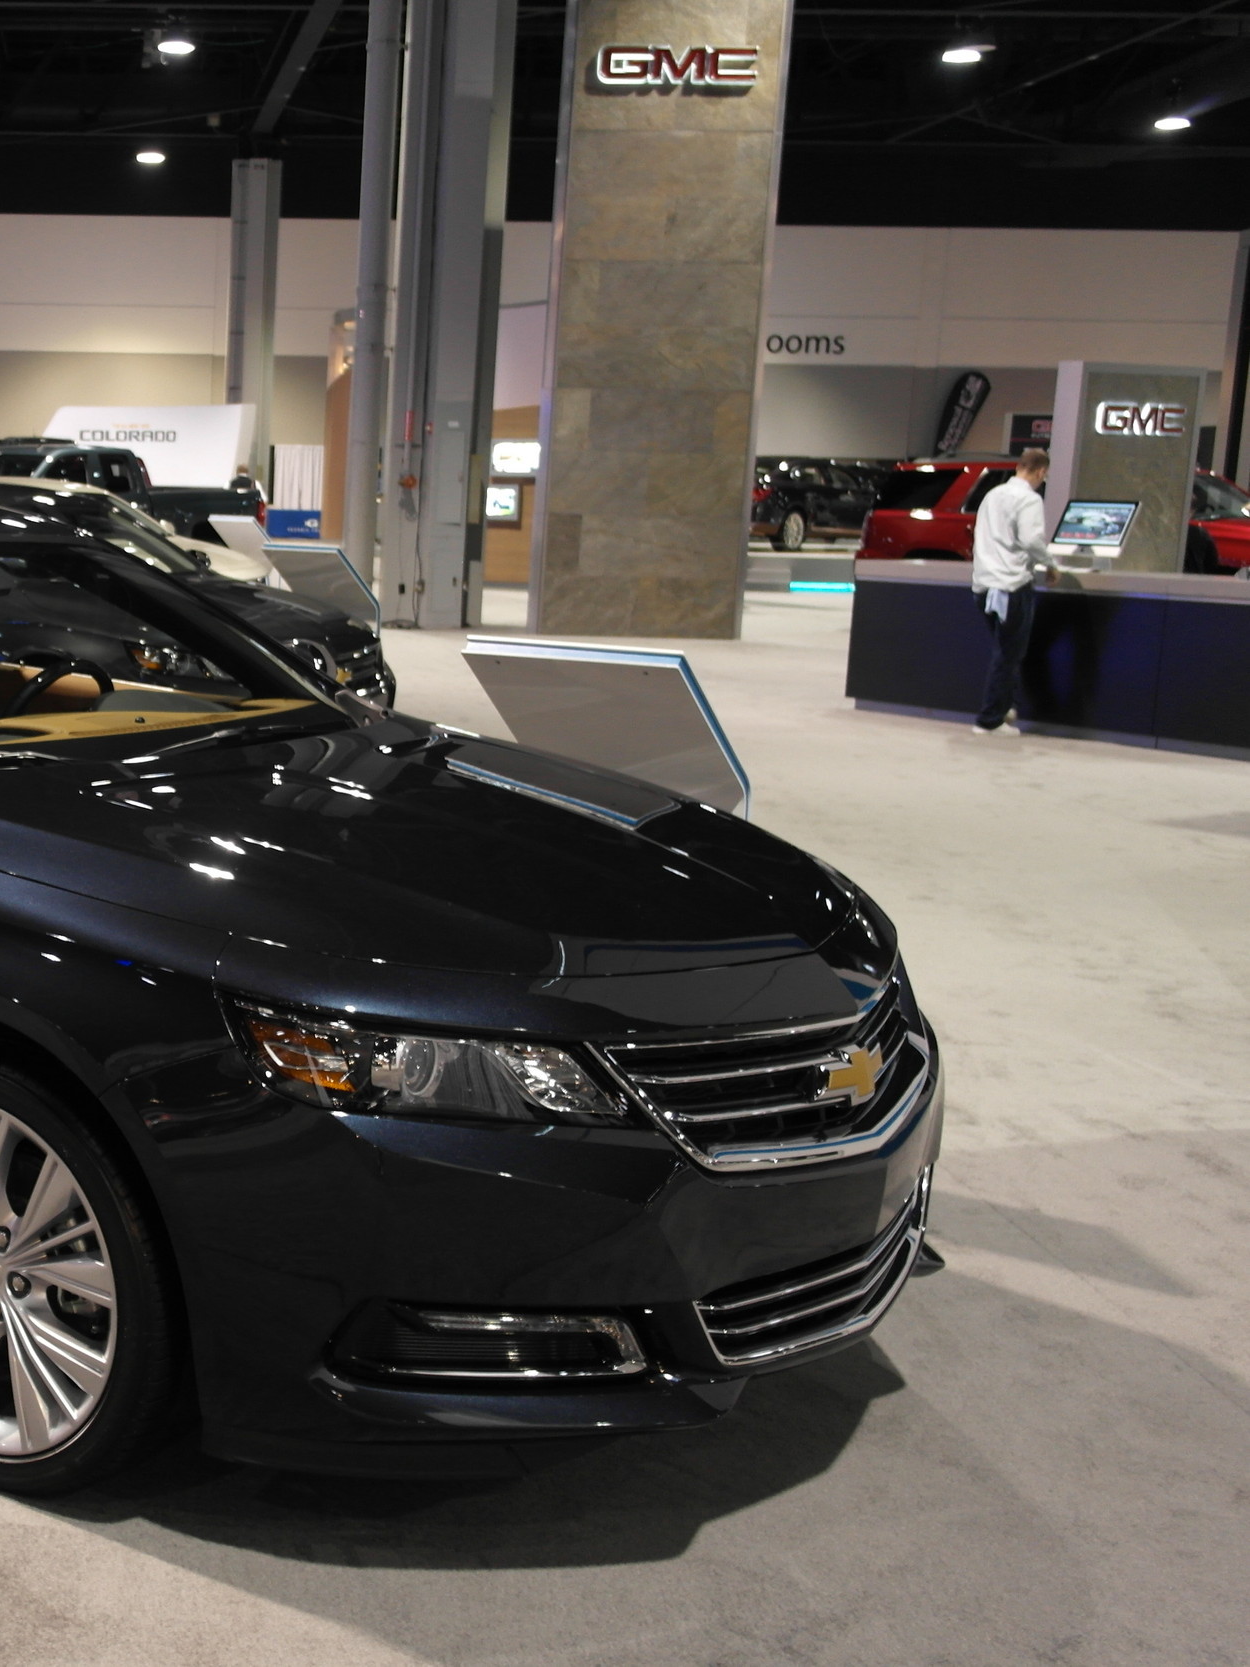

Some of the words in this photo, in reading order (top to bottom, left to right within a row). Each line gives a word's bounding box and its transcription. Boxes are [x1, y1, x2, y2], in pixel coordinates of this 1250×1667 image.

[597, 44, 760, 86] GMC
[79, 430, 177, 442] COLORADO
[1095, 401, 1187, 437] GMC
